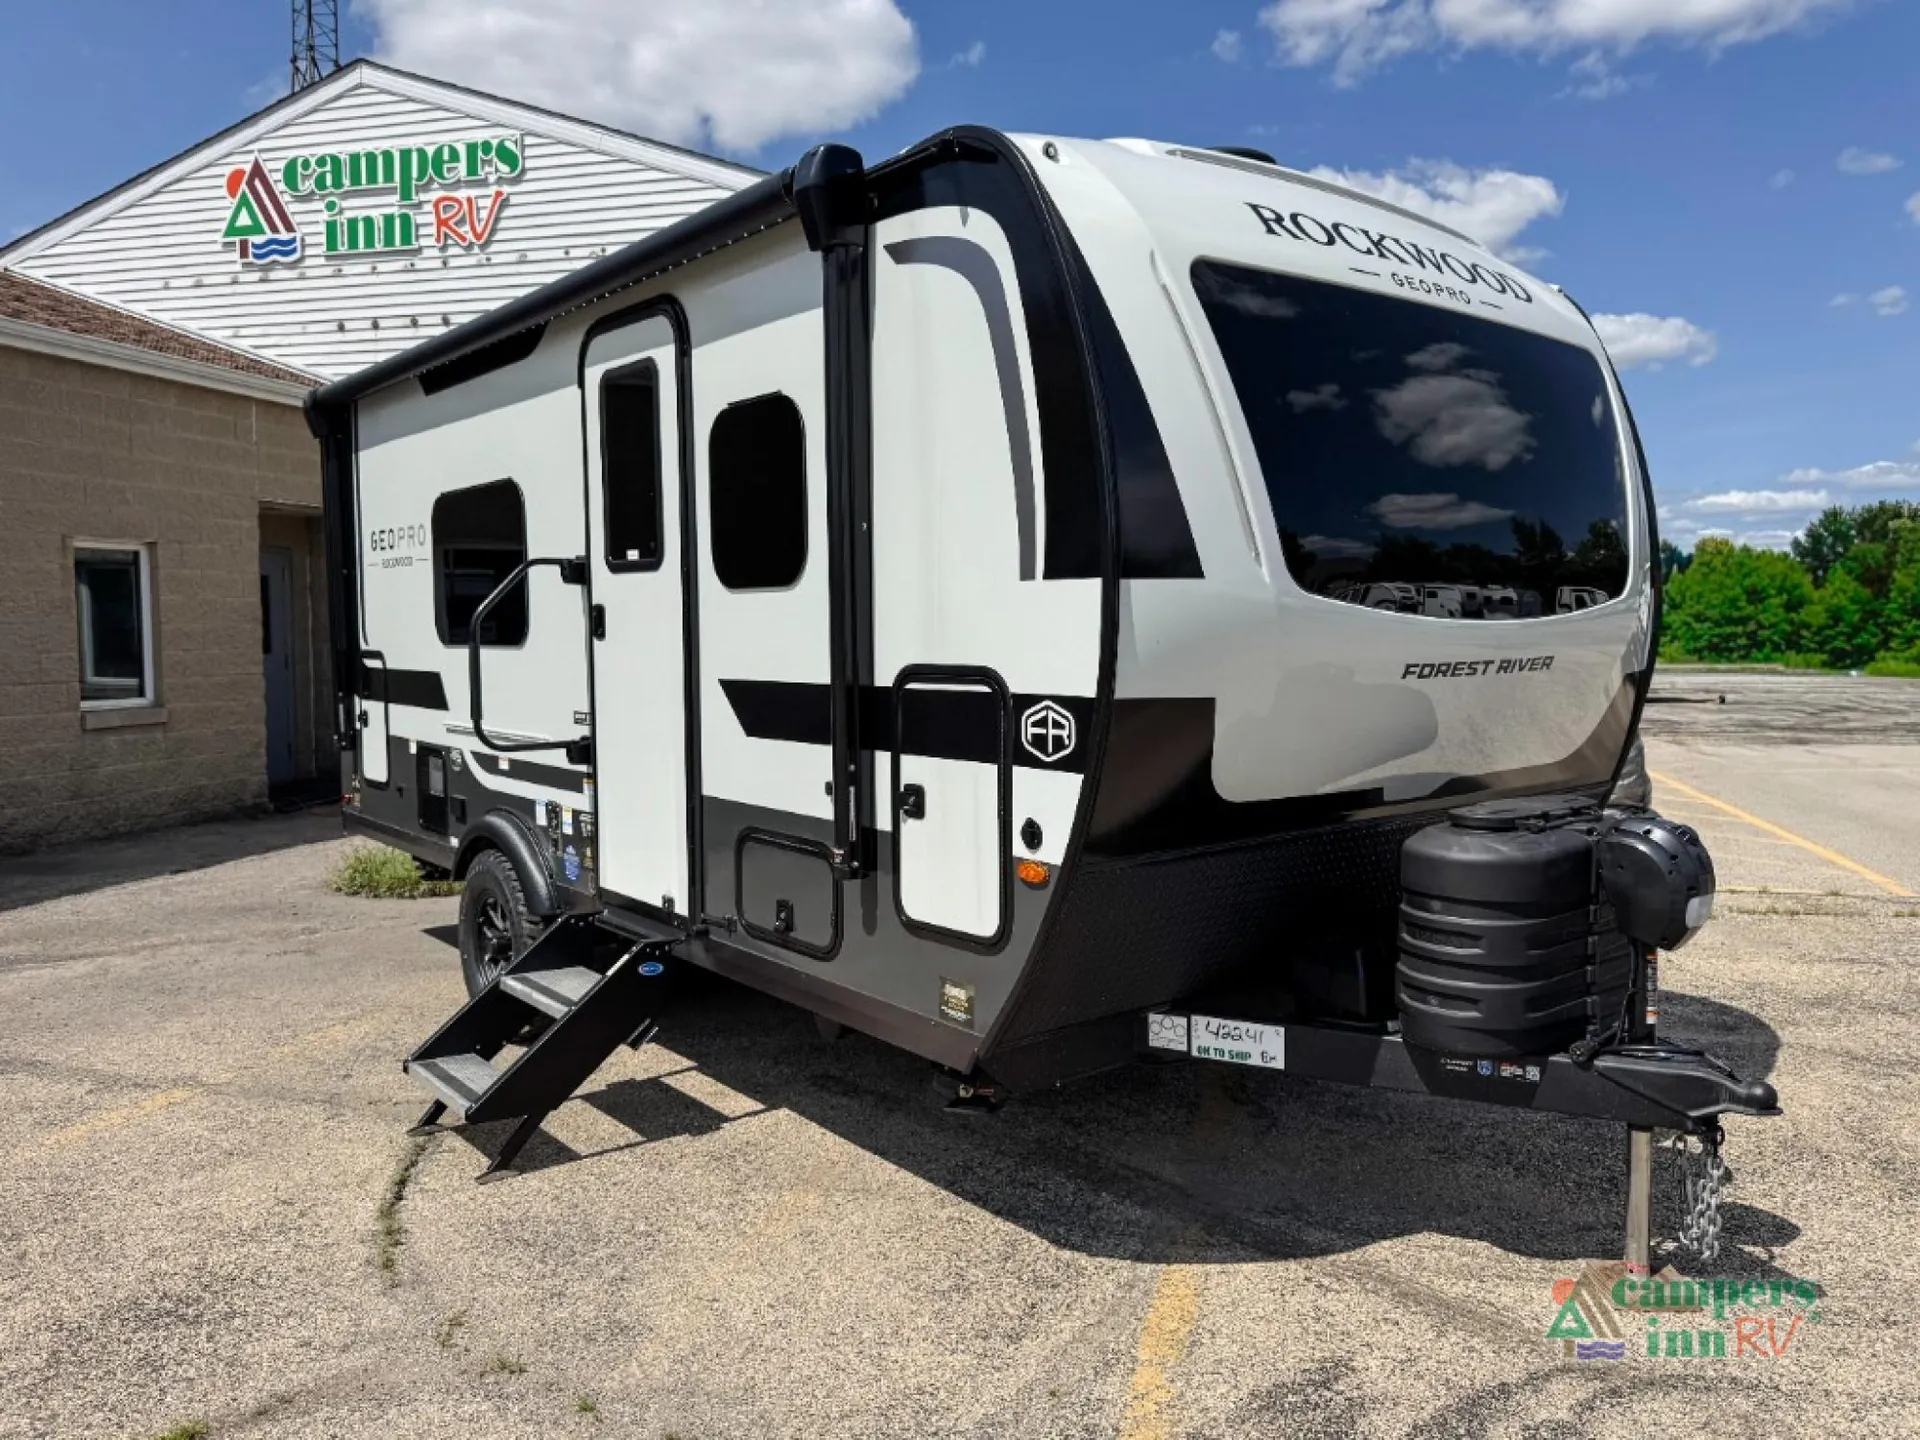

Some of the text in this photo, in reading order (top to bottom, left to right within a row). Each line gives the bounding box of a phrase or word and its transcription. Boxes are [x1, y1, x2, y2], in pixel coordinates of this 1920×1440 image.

[282, 134, 525, 203] campers
[323, 189, 506, 252] inn RV
[1244, 201, 1532, 303] ROCKWOOD
[1391, 272, 1471, 304] GEOPRO
[371, 523, 426, 552] GEOPRO
[1401, 655, 1555, 680] FOREST RIVER
[1196, 1044, 1211, 1056] OK
[1212, 1047, 1226, 1058] TO
[1227, 1049, 1252, 1062] SHIP
